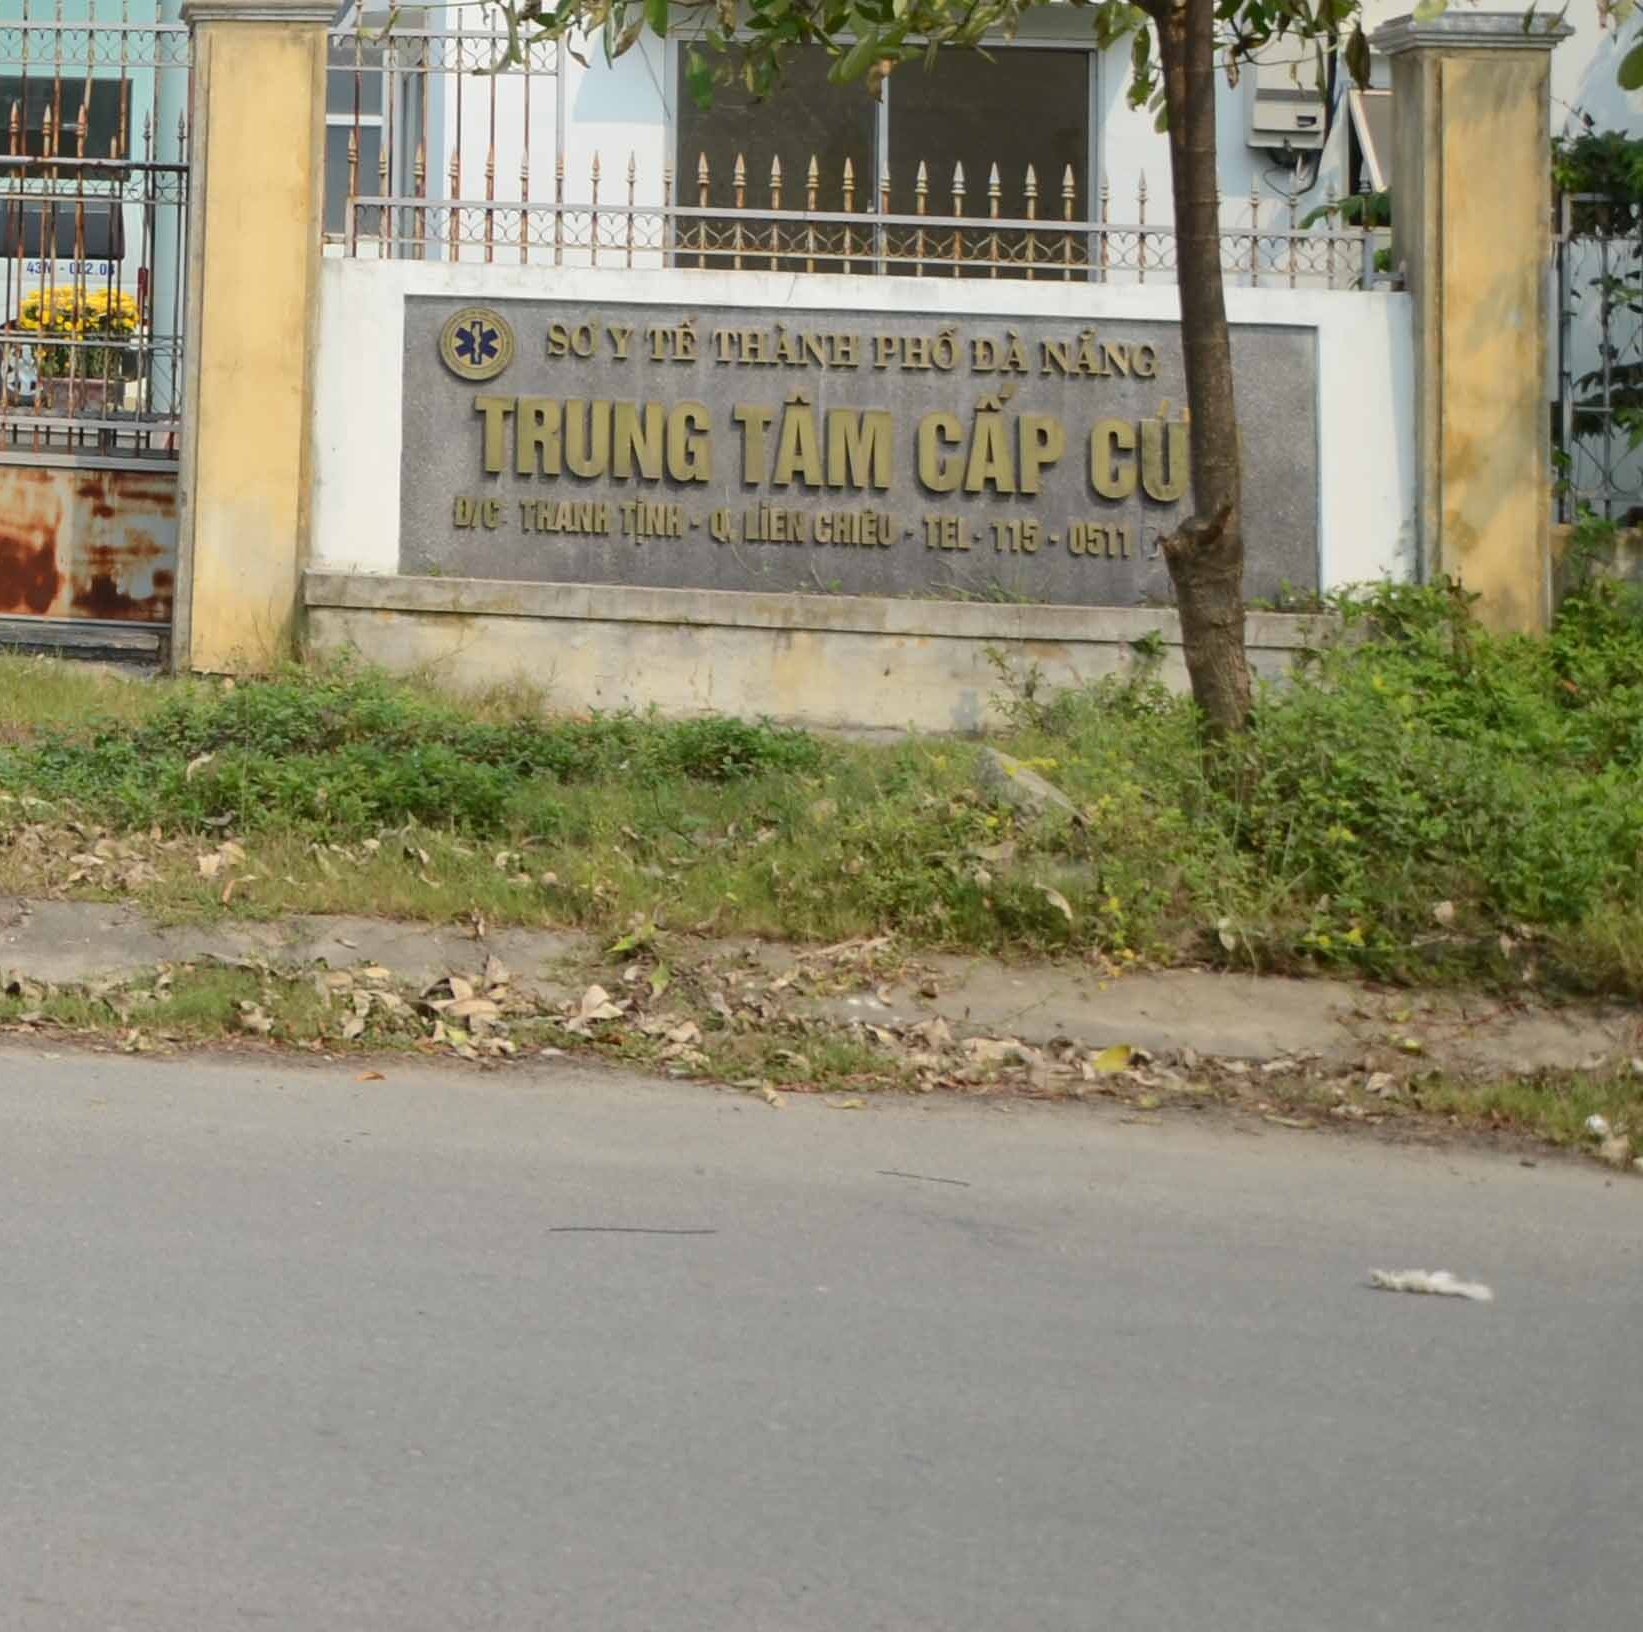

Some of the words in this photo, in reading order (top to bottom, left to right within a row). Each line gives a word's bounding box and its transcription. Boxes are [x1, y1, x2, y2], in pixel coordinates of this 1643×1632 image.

[608, 324, 632, 360] Y
[644, 316, 699, 361] TẾ
[712, 322, 859, 370] THÀNH
[873, 326, 965, 371] PHỐ
[971, 330, 1028, 372] ĐÀ
[474, 394, 711, 483] TRUNG
[732, 386, 893, 489] TÂM
[918, 384, 1065, 497] CẤP
[519, 499, 609, 537] THANH
[991, 518, 1041, 554] 115
[1068, 518, 1132, 559] 0511
